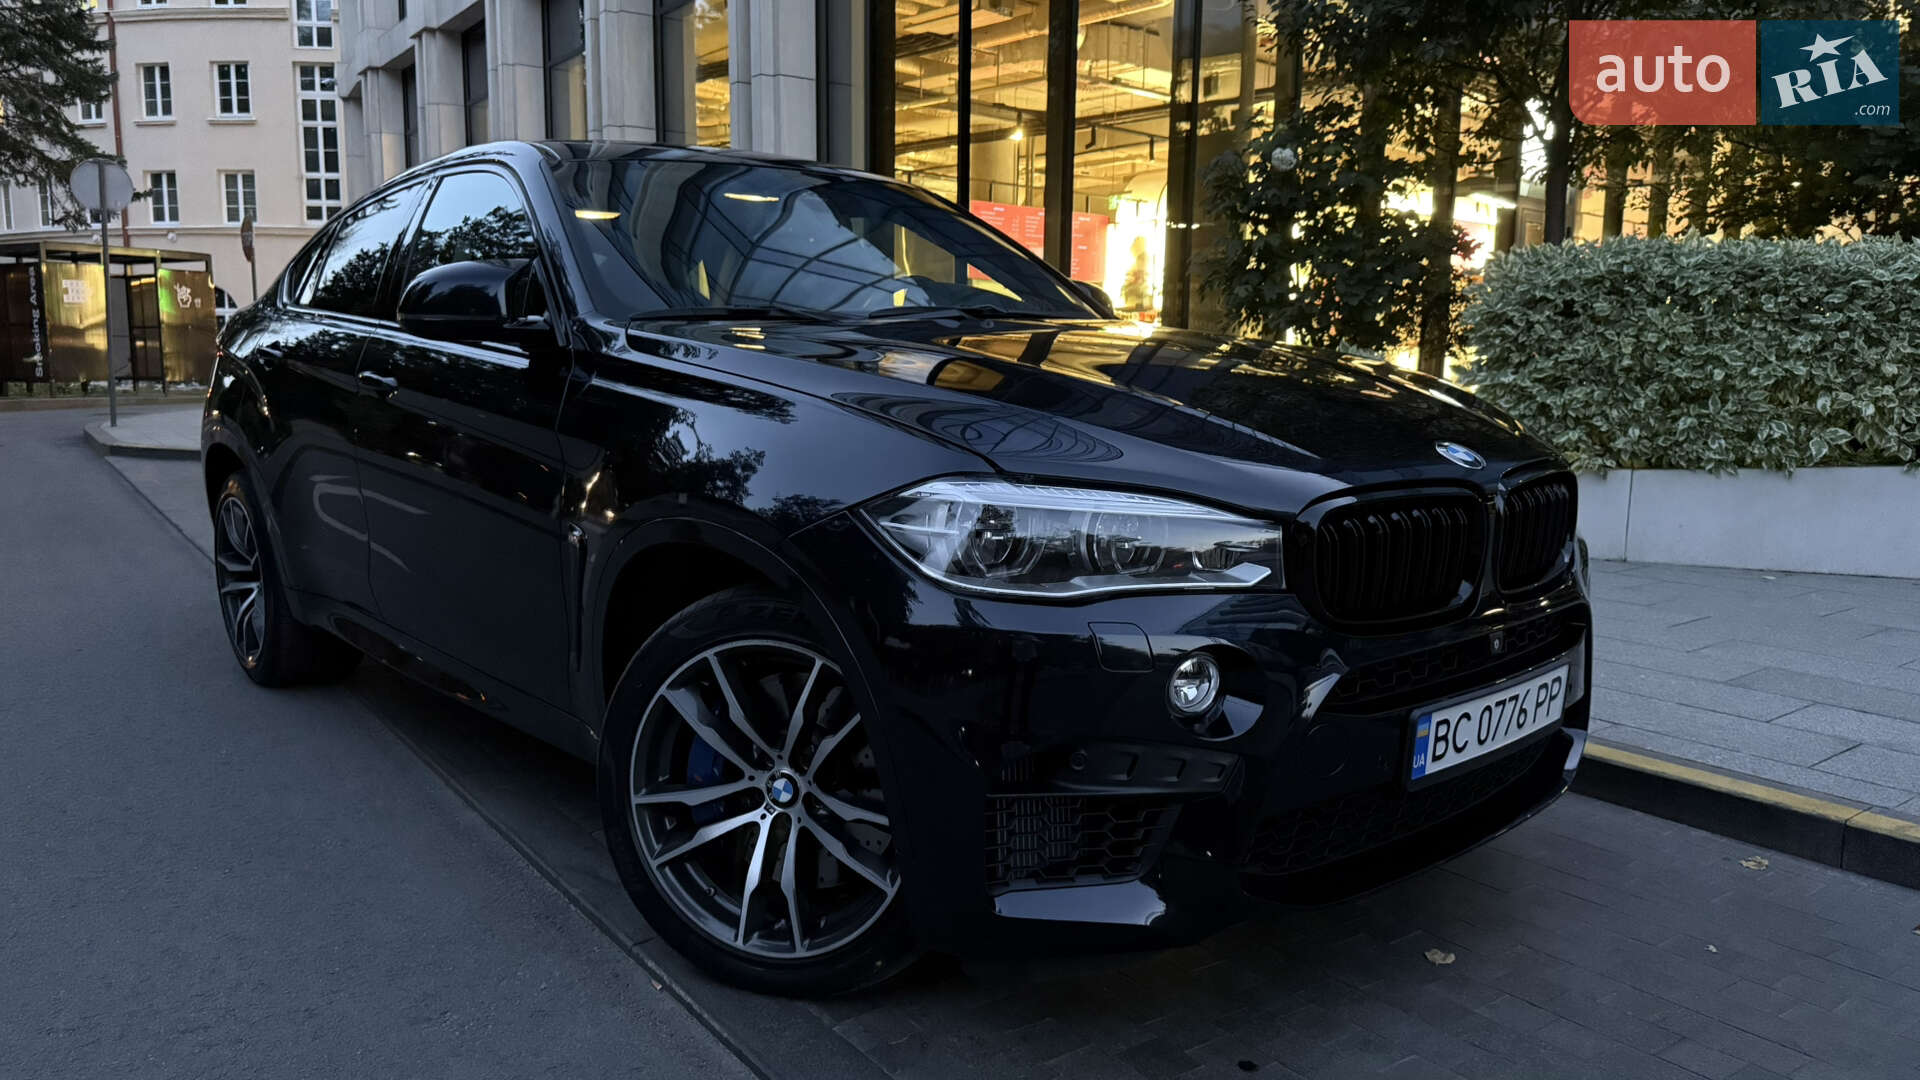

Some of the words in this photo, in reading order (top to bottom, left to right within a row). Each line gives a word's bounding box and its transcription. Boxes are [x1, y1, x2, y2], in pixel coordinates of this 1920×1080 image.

[28, 266, 37, 304] Area
[1431, 711, 1472, 763] BC
[1477, 688, 1532, 746] 0776
[1533, 675, 1562, 724] PP
[1412, 754, 1425, 769] UA
